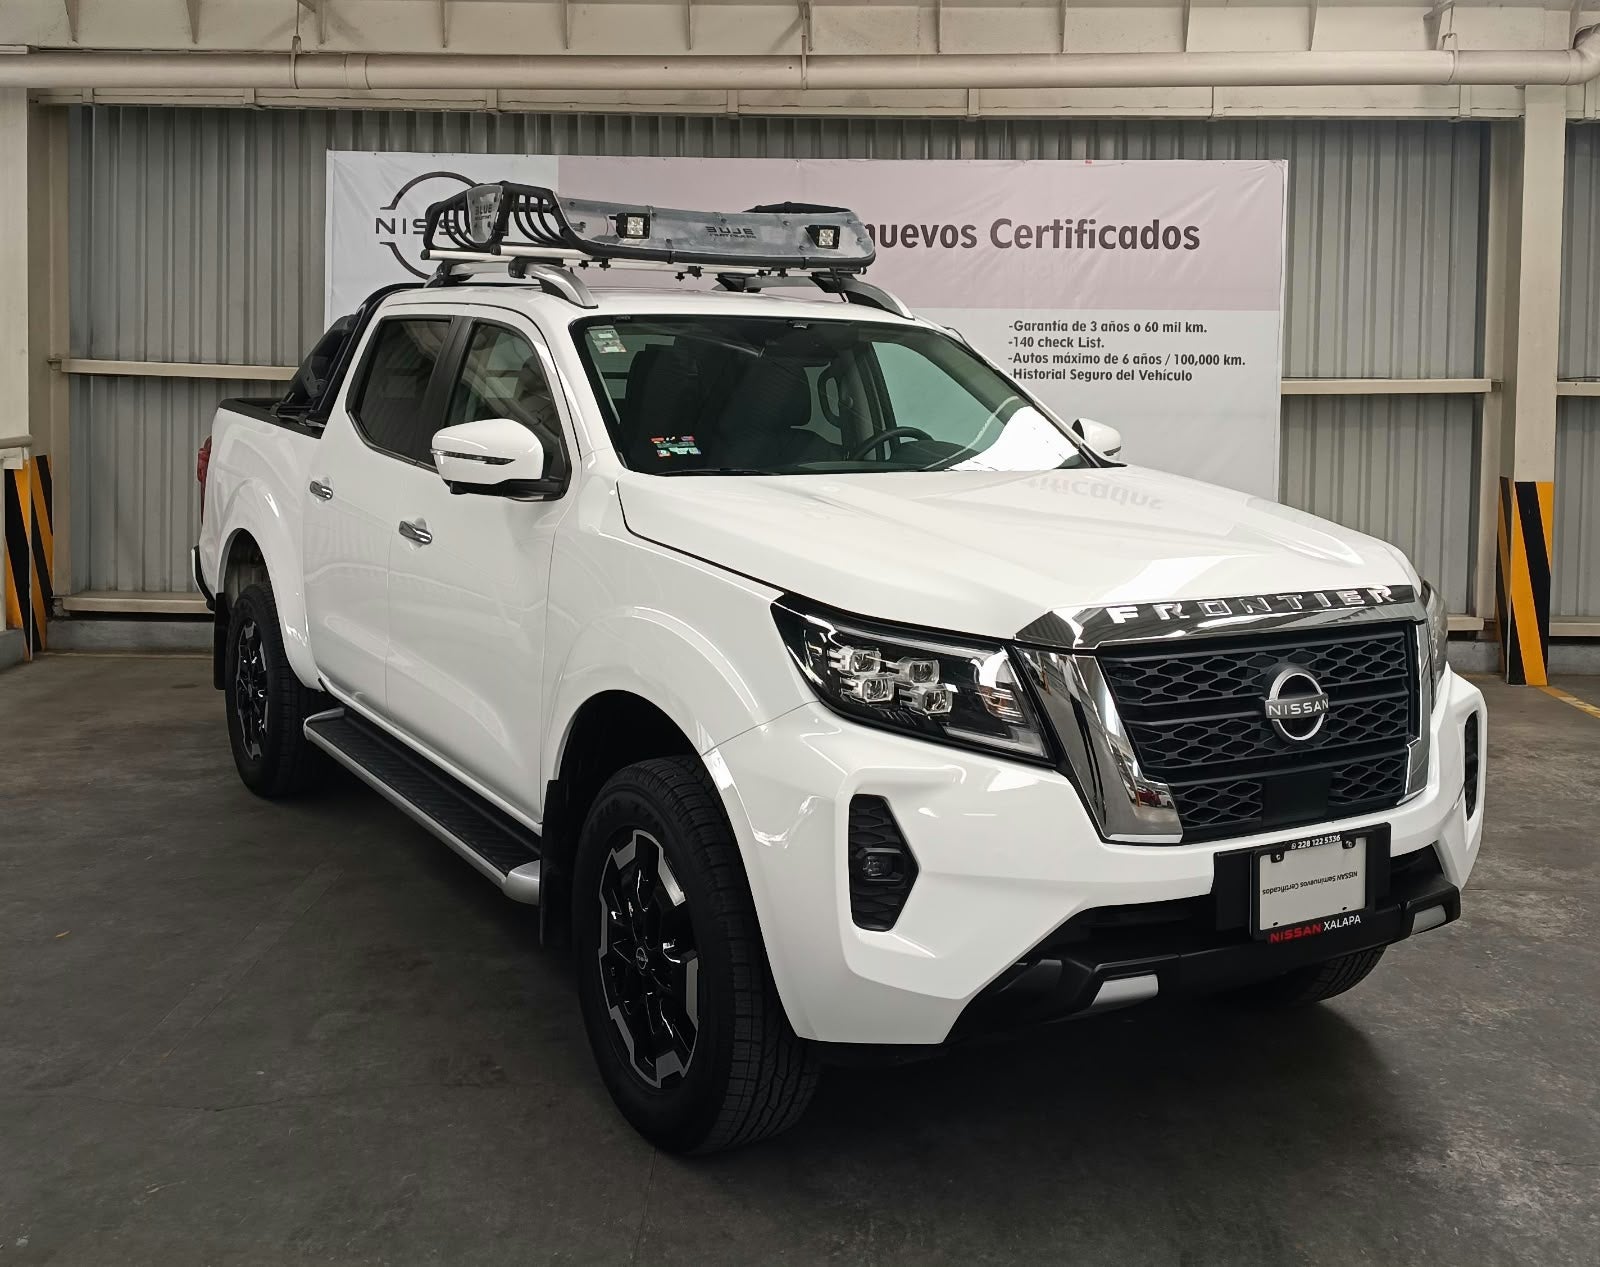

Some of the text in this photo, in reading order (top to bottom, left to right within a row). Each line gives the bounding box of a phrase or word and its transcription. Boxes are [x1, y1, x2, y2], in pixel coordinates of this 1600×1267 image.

[990, 218, 1200, 250] Certificados
[1009, 319, 1207, 333] -Garantía de 3 años o 60 mil km.
[1037, 337, 1074, 348] check
[1078, 337, 1105, 348] List.
[1008, 352, 1245, 366] -Autos máximo de 6 años / 100,000 km.
[1070, 369, 1113, 382] Seguro
[1116, 369, 1135, 381] del
[1139, 369, 1192, 381] Vehículo
[1105, 585, 1396, 624] FRONTIER
[1268, 699, 1329, 716] NISSAN
[1297, 840, 1311, 849] 228
[1312, 838, 1324, 846] 122
[1262, 871, 1358, 895] NISSAN Seminuevos Certificados
[1270, 914, 1361, 943] NISSAN XALAPA
